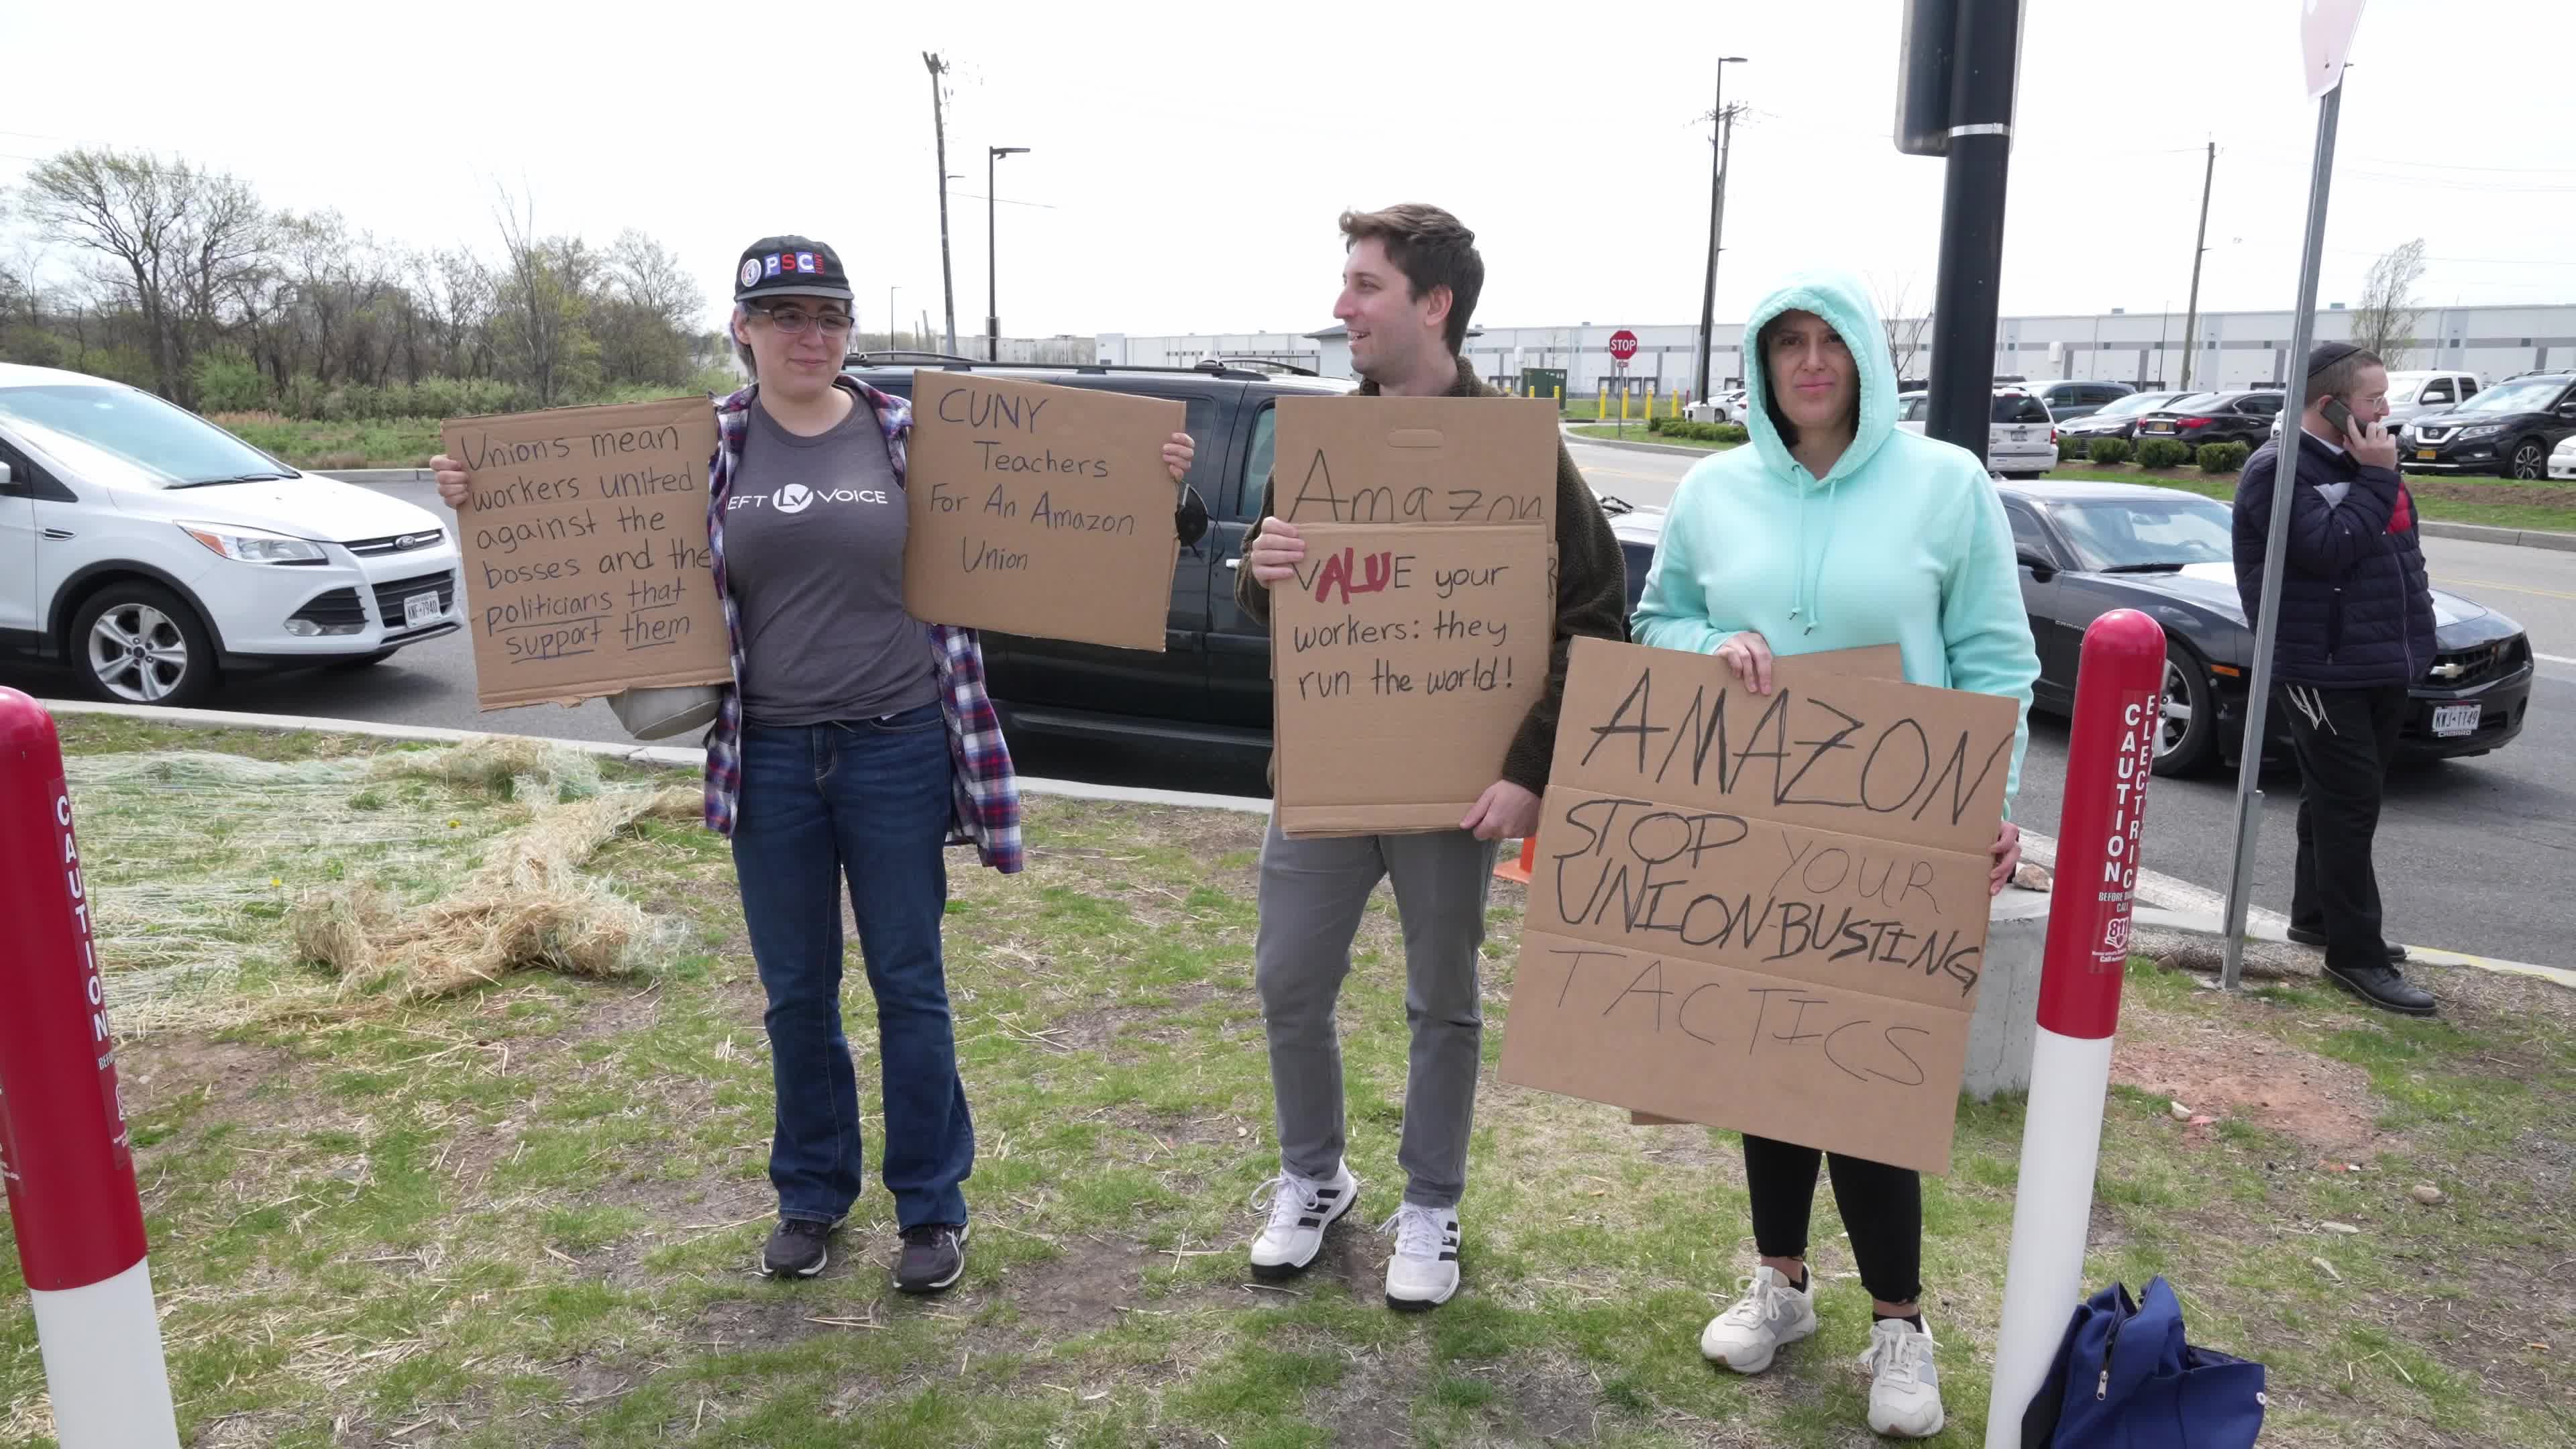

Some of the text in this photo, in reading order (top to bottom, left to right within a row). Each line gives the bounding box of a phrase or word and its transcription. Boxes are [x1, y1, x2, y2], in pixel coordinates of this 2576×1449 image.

[766, 254, 815, 275] PSC
[1611, 339, 1635, 351] STOP
[938, 388, 1051, 433] CUNY
[462, 425, 680, 471] Unions mean
[973, 440, 1109, 478] Teachers
[472, 462, 694, 512] workers united
[727, 494, 768, 511] EFT
[816, 488, 889, 504] VOICE
[930, 483, 1135, 536] For An Amazon
[476, 506, 666, 553] against the
[482, 537, 712, 590] bosses and the
[962, 536, 1028, 573] Union
[1292, 546, 1415, 604] VALUE
[1434, 565, 1511, 600] your
[487, 576, 687, 637] politicians that
[505, 613, 691, 660] support them
[1294, 609, 1507, 653] workers: they
[1297, 656, 1513, 702] run the world!
[1580, 667, 2014, 826] AMAZON
[2104, 704, 2141, 882] CAUTION
[2123, 694, 2156, 889] ELECTRIC
[1565, 798, 1941, 914] STOP YOUR
[56, 794, 109, 1042] CAUTION
[2098, 891, 2124, 902] BEFORE
[1548, 949, 1931, 1086] TACTICS
